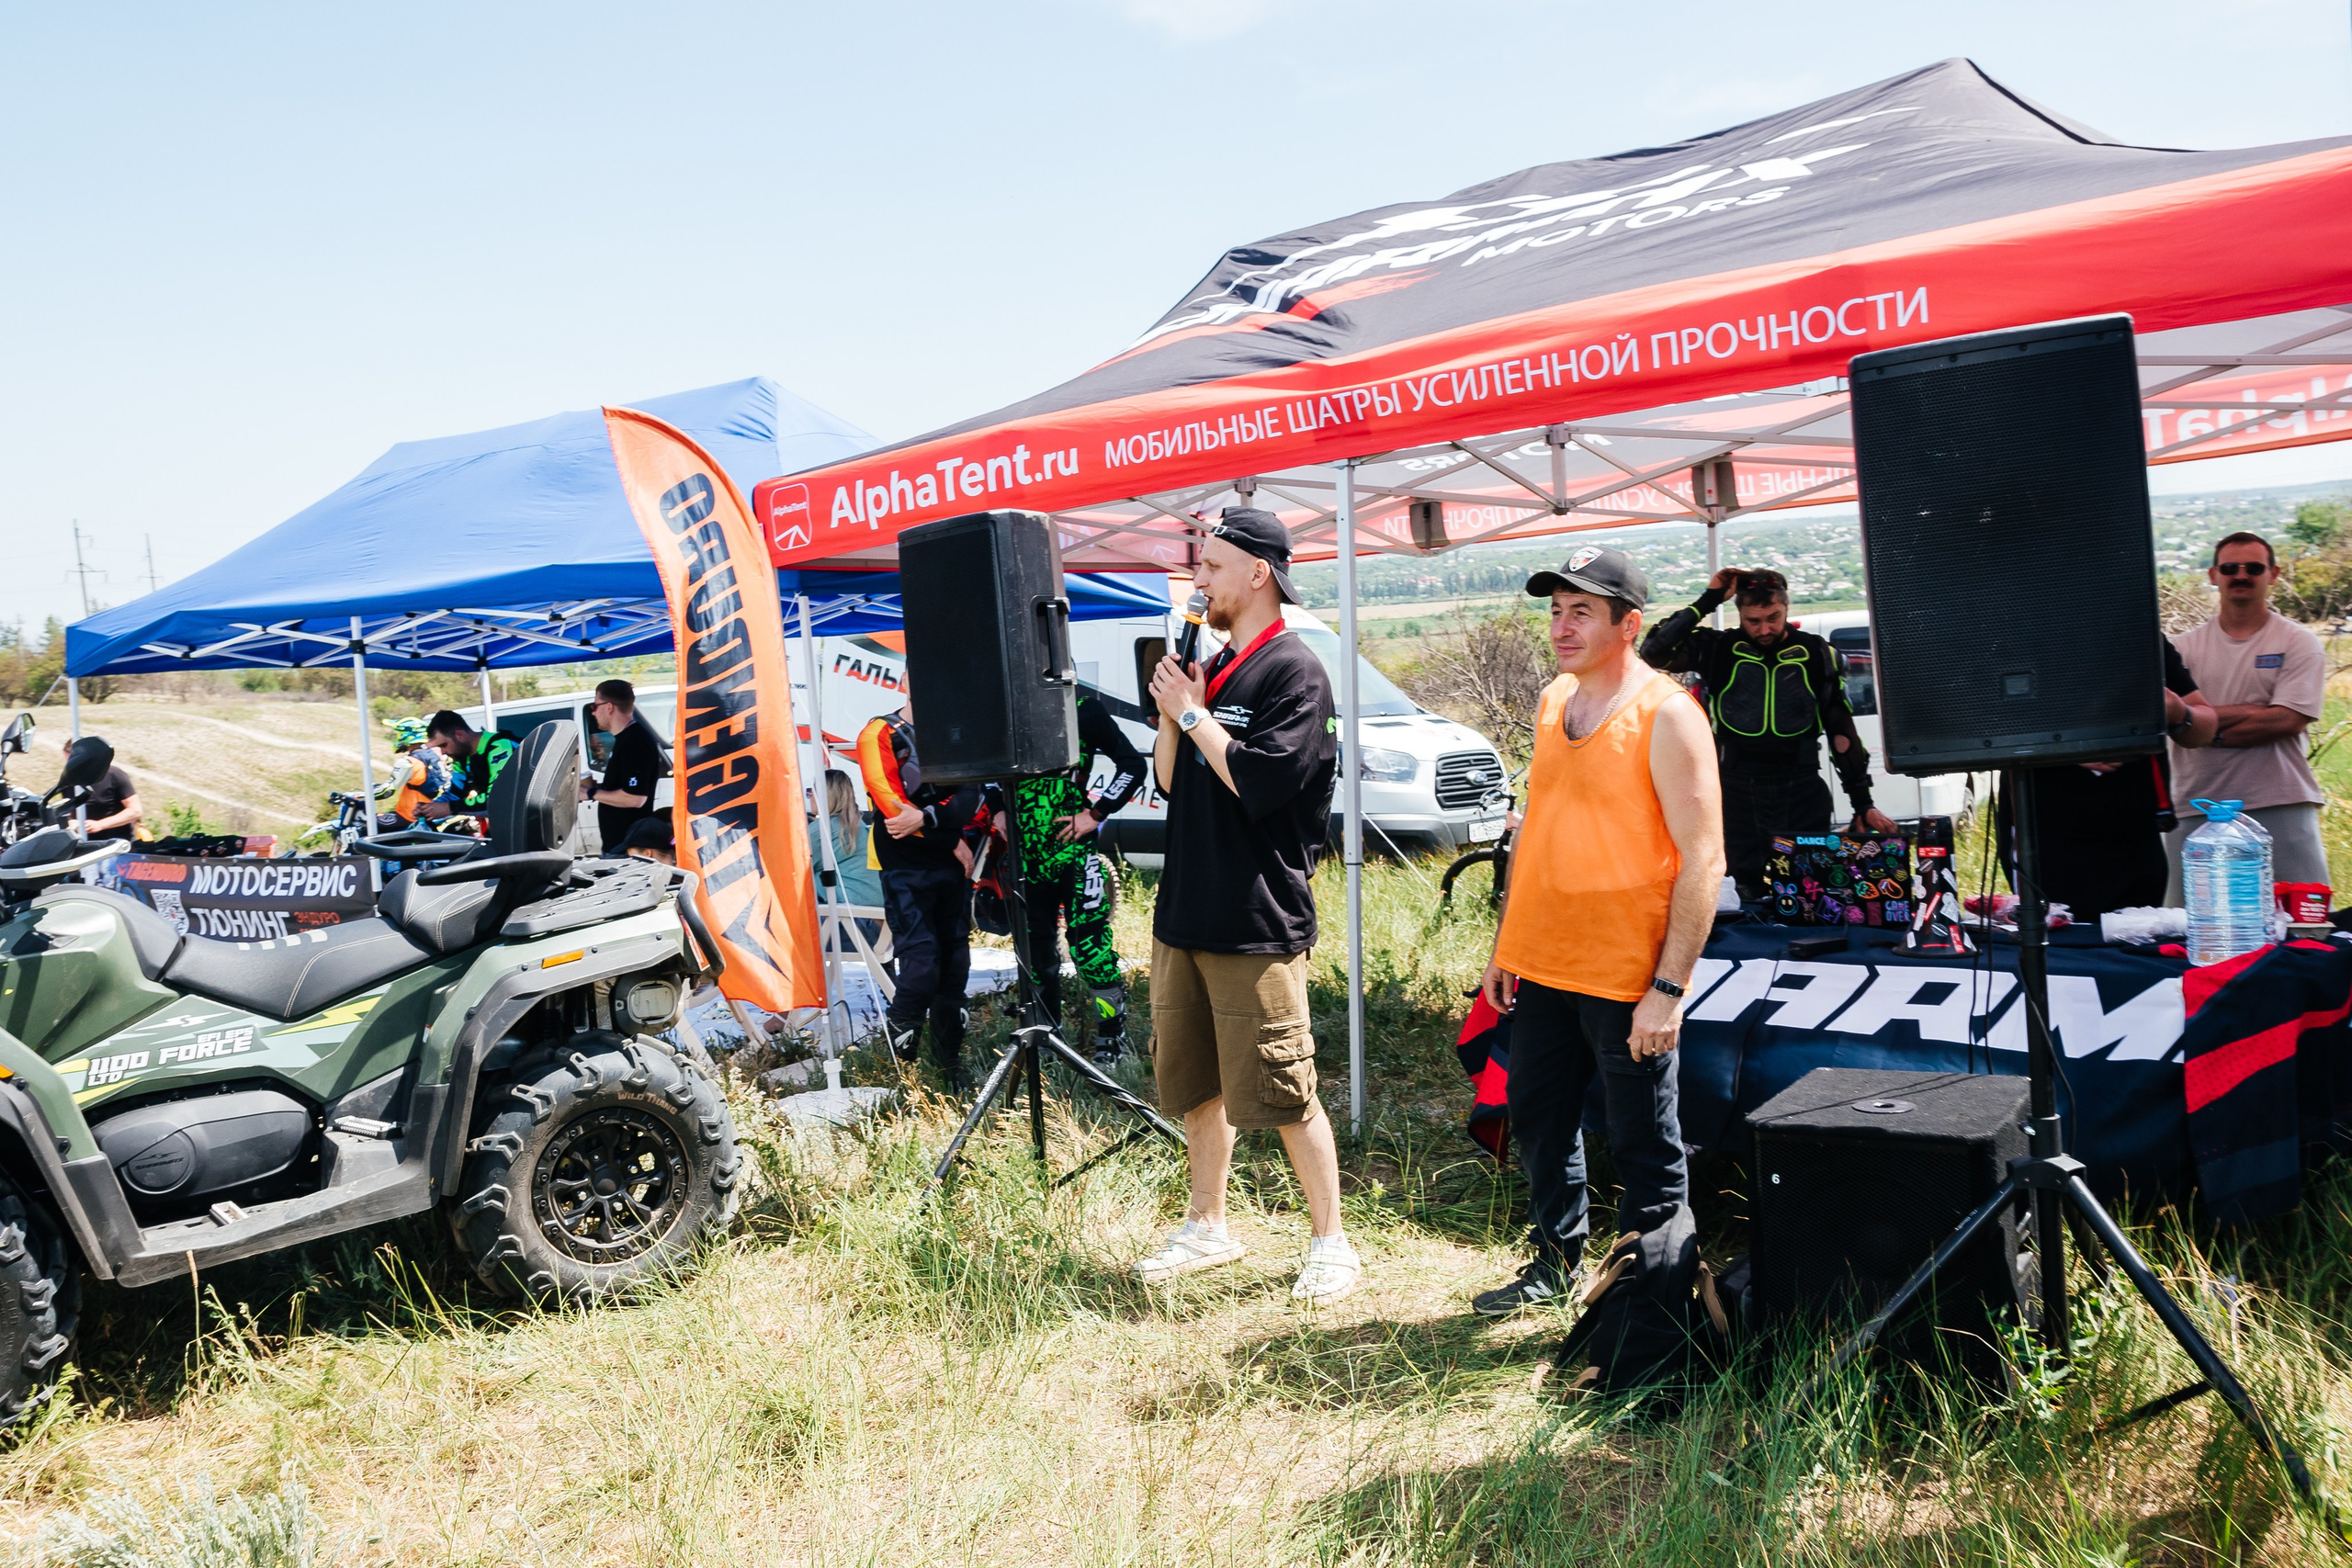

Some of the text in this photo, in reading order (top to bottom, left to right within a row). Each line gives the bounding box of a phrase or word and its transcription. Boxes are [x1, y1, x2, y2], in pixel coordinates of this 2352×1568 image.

[1460, 186, 1792, 268] MOTORS
[1105, 286, 1929, 469] МОБИЛЬНЫЕ ШАТРЫ УСИЛЕННОЙ ПРОЧНОСТИ
[830, 445, 1079, 530] AlphaTent.ru
[1796, 836, 1826, 846] DANCE
[189, 864, 357, 897] МОТОСЕРВИС
[1885, 900, 1910, 911] GAME
[1885, 910, 1911, 922] OVER
[189, 908, 290, 939] ТЮНИНГ
[197, 1027, 254, 1043] EFI EPS
[89, 1036, 254, 1076] 1100 FORCE
[87, 1070, 124, 1088] LTD
[1770, 1173, 1781, 1185] 6
